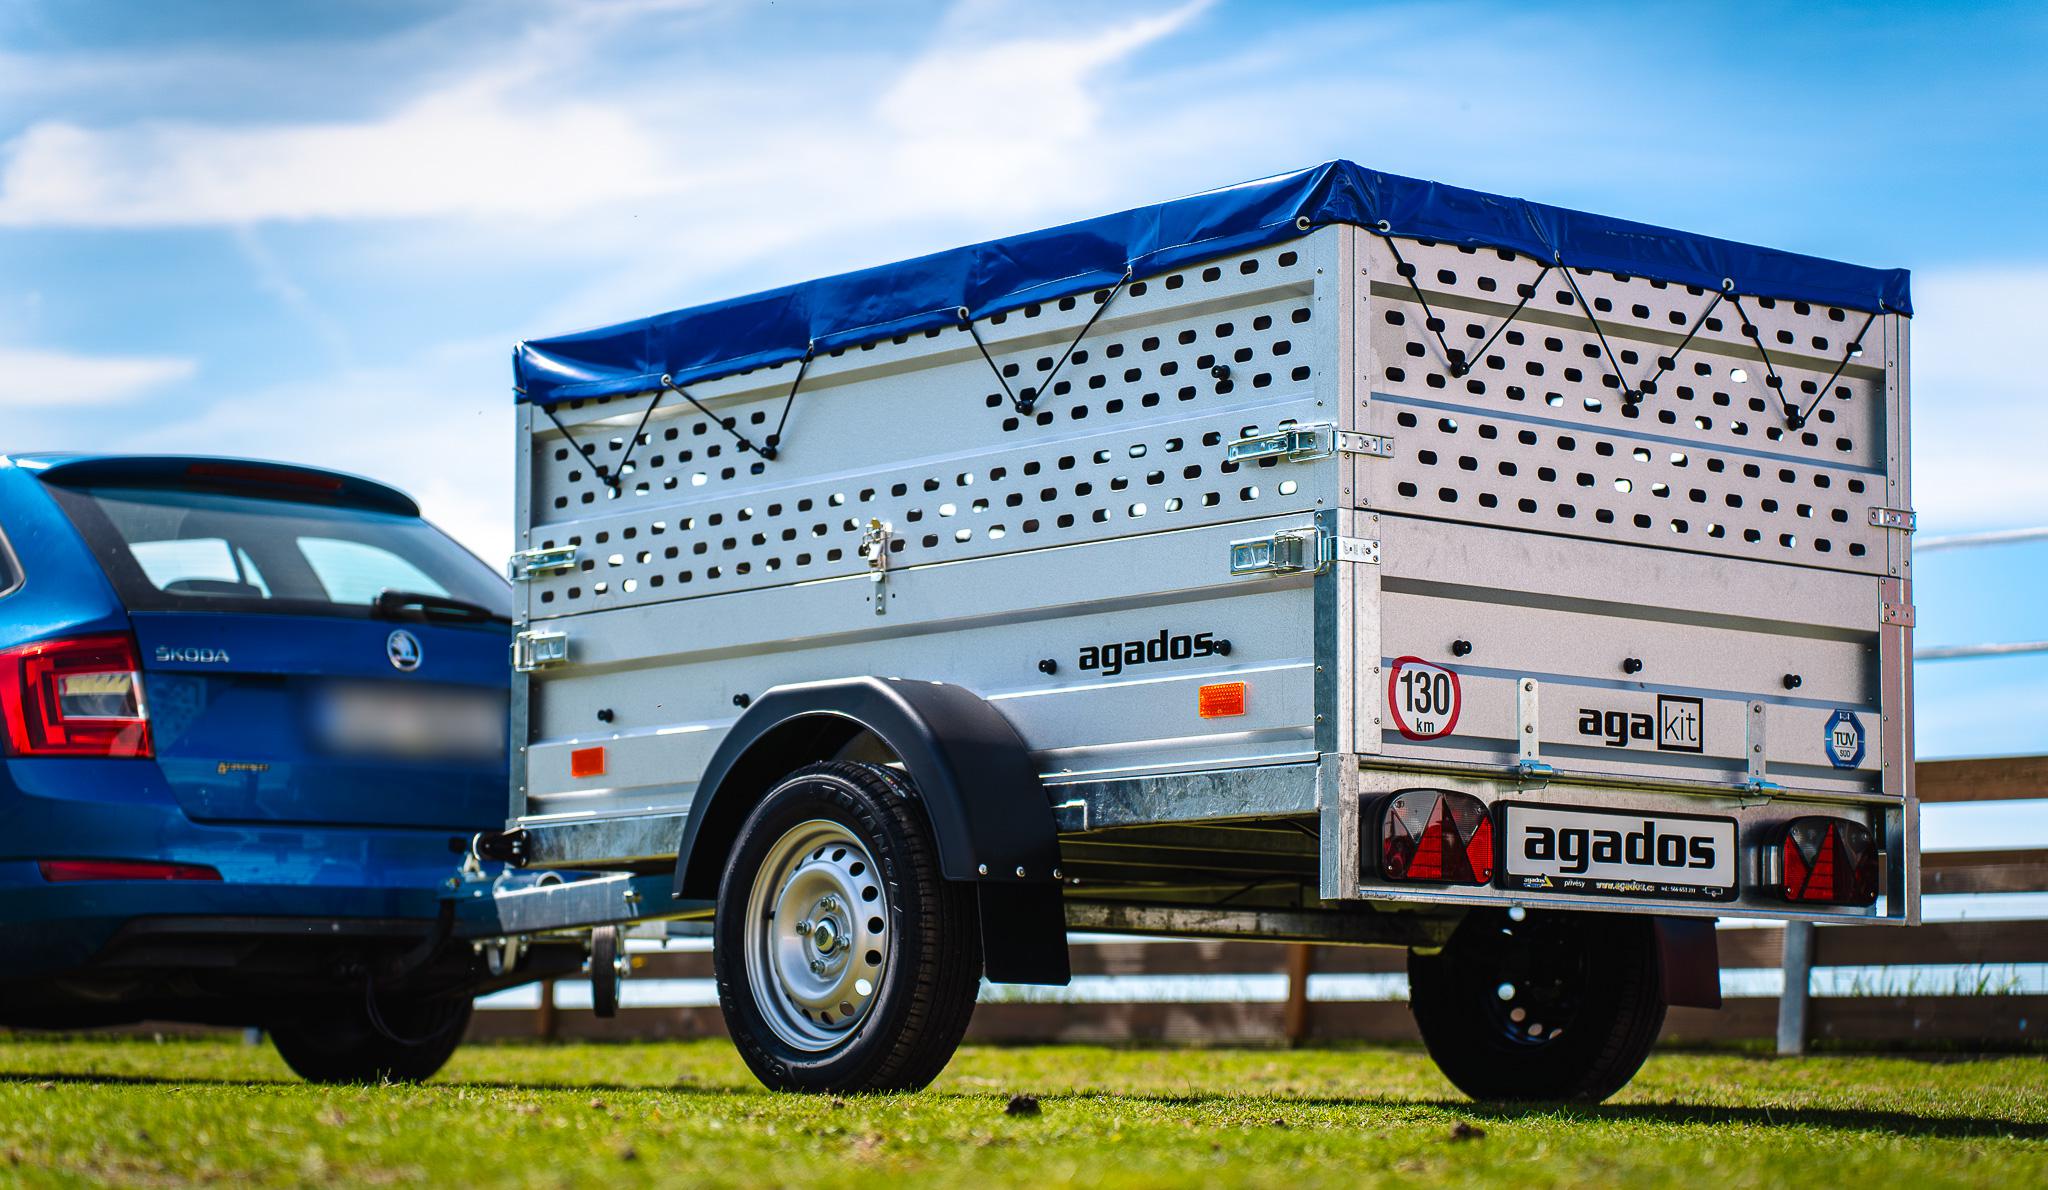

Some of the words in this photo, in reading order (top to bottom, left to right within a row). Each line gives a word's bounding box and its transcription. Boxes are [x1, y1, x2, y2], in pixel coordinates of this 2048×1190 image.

[155, 645, 230, 663] ŠKODA
[1079, 629, 1213, 676] agados
[1400, 670, 1450, 716] 130
[1416, 717, 1435, 733] km
[1578, 708, 1654, 747] aga
[1664, 706, 1697, 742] kit
[1834, 731, 1856, 746] TÜV
[1524, 821, 1715, 874] agados
